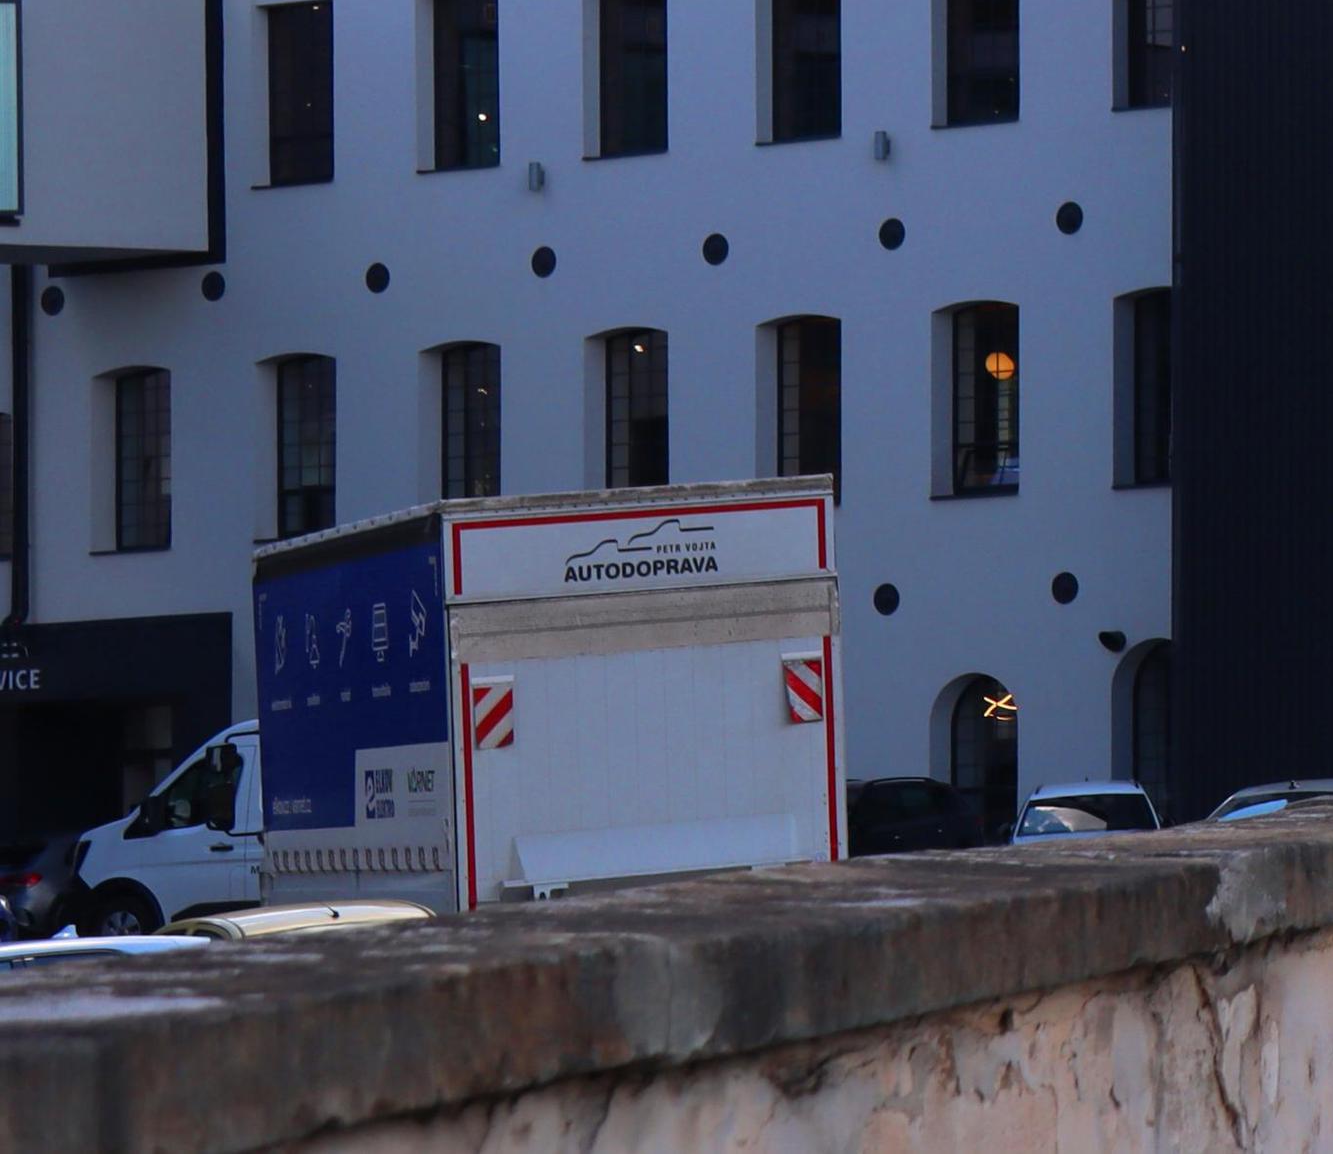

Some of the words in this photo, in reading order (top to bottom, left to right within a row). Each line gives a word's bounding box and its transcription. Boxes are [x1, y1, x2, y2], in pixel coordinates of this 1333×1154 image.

[656, 544, 681, 554] PETR
[685, 541, 717, 553] VOJTA
[564, 556, 719, 583] AUTODOPRAVA
